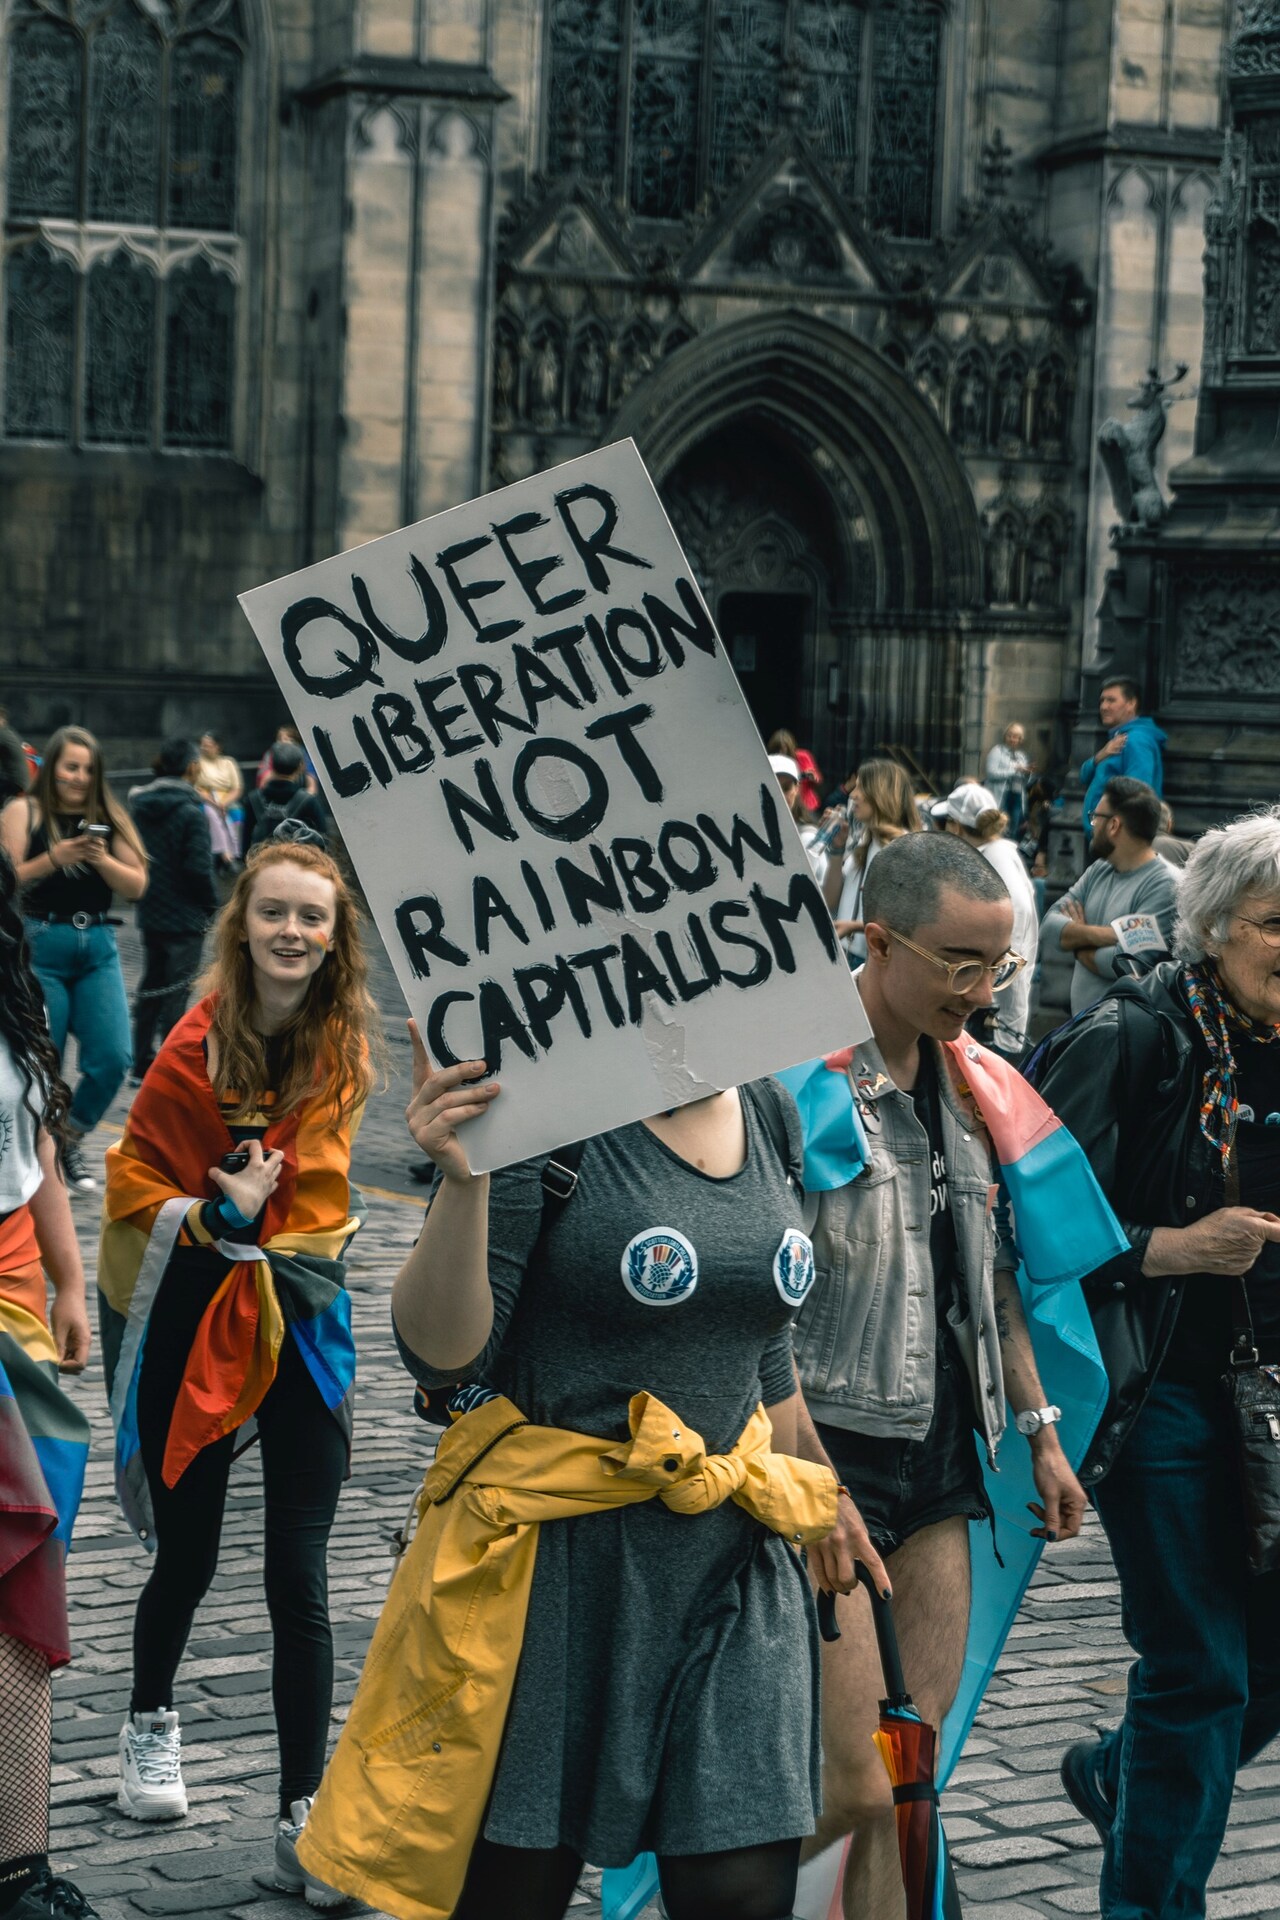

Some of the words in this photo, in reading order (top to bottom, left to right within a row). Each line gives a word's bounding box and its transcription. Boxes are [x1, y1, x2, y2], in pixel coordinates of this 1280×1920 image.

[281, 483, 655, 699] QUEER
[312, 577, 716, 798] LIBERATION
[395, 783, 784, 980] RAINBOW
[439, 703, 664, 855] NOT
[427, 874, 838, 1083] CAPITALISM
